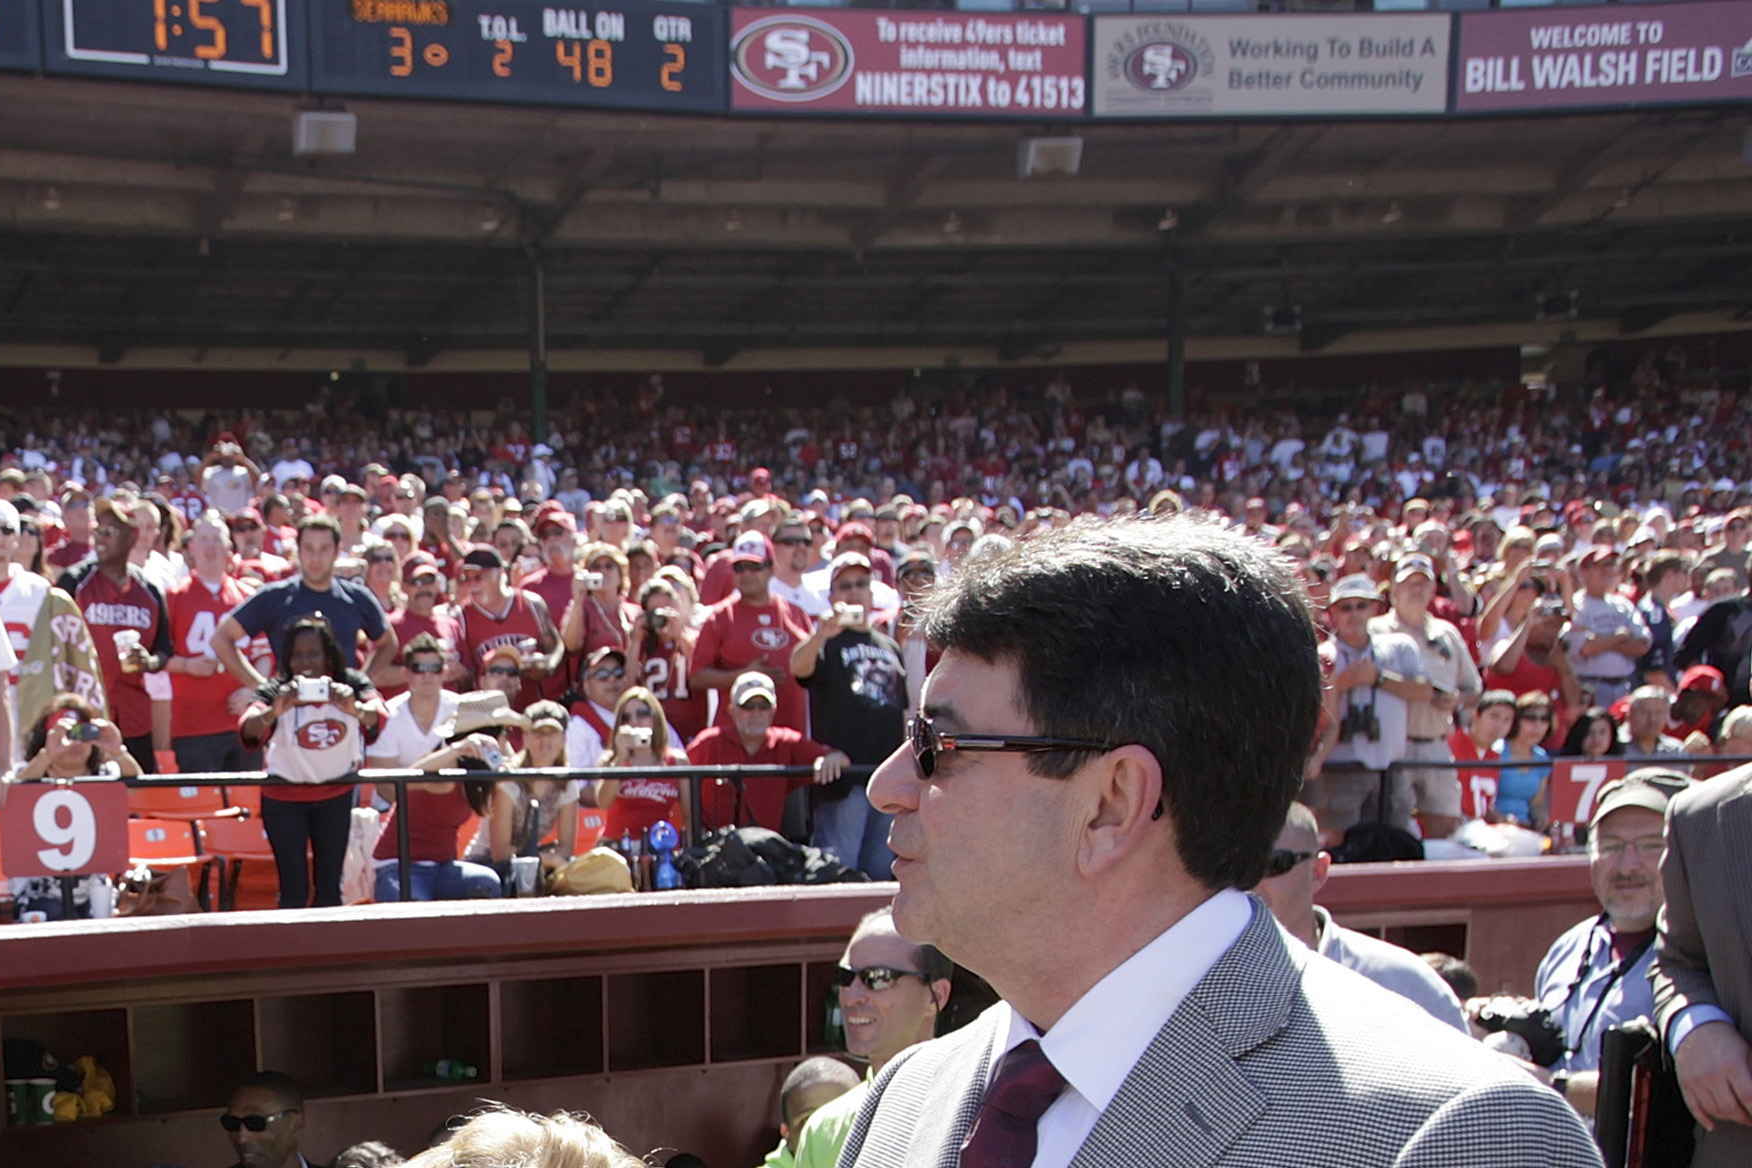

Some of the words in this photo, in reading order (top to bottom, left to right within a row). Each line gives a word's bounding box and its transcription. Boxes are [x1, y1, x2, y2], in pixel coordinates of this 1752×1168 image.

[543, 8, 592, 39] BALL
[595, 11, 625, 42] ON
[653, 15, 692, 42] QTR
[876, 17, 898, 42] To
[900, 18, 962, 45] receive
[965, 18, 1013, 45] 49ers
[1016, 21, 1066, 46] ticket
[1529, 22, 1632, 50] WELCOME
[1636, 20, 1664, 45] TO
[492, 38, 513, 77] 2
[555, 38, 613, 88] 48
[659, 43, 686, 92] 2
[899, 45, 1006, 74] information,
[1008, 48, 1043, 71] text
[1228, 37, 1319, 64] Working
[1327, 36, 1351, 59] To
[1358, 36, 1414, 60] Build
[1419, 37, 1436, 59] A
[1228, 68, 1293, 91] Better
[1300, 67, 1425, 94] Community
[1464, 55, 1525, 94] BILL
[1531, 49, 1639, 91] WALSH
[1644, 45, 1723, 85] FIELD
[854, 72, 983, 109] NINERSTIX
[987, 77, 1011, 108] to
[1014, 76, 1086, 110] 41513
[84, 601, 152, 629] 49ERS
[644, 655, 690, 700] 21
[1570, 764, 1608, 823] 7
[32, 788, 97, 872] 9
